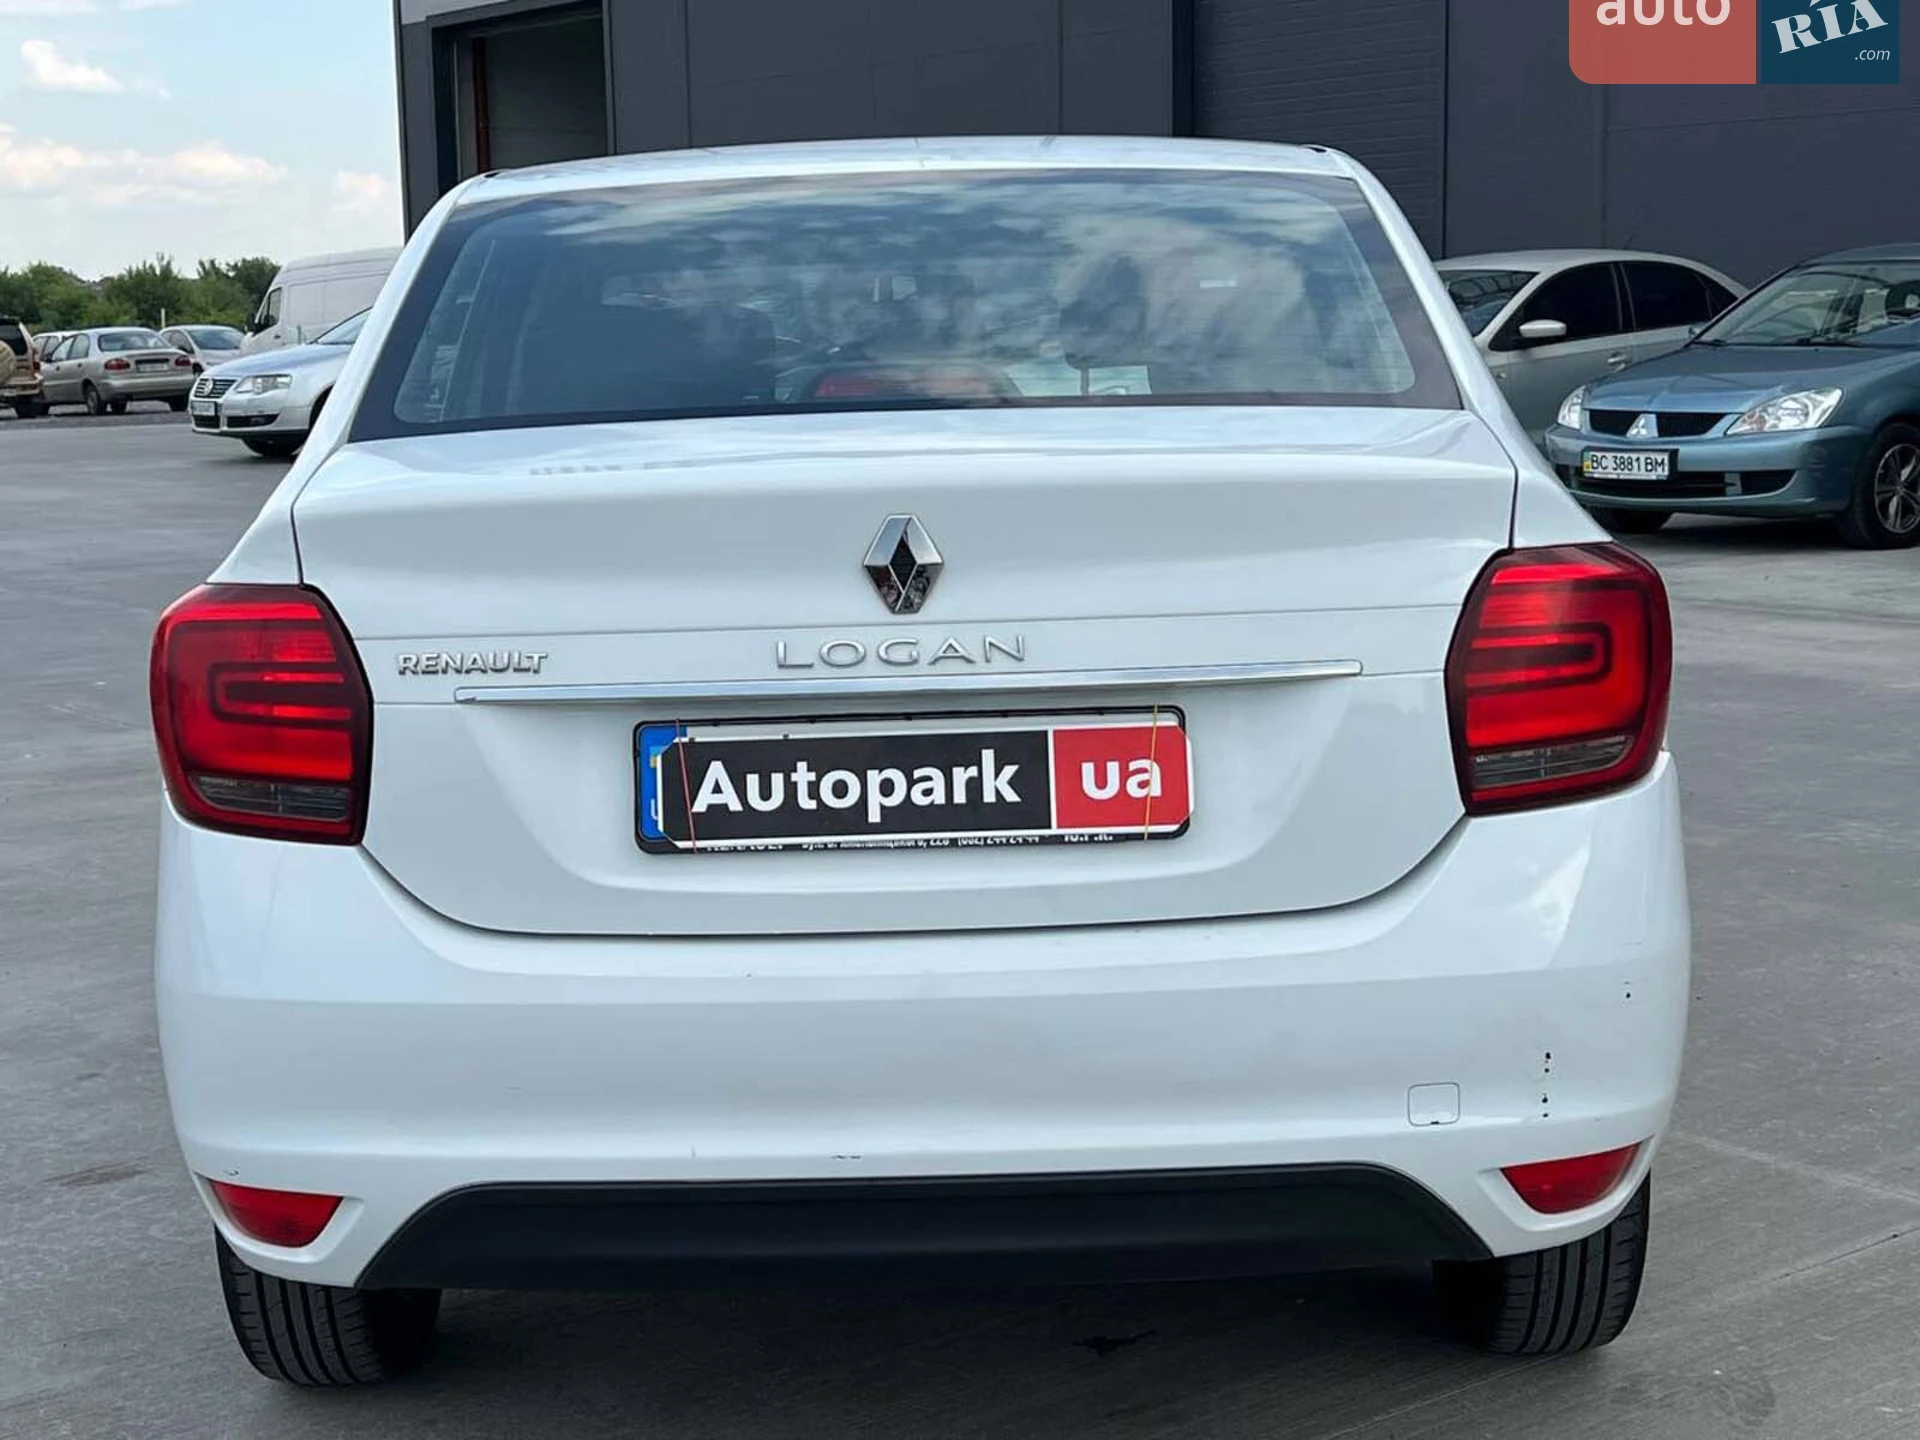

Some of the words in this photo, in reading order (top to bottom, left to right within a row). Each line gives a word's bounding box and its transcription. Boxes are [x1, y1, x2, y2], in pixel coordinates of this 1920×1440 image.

[1590, 454, 1609, 471] BC
[1611, 455, 1642, 472] 3881
[1644, 456, 1666, 473] BM
[397, 651, 549, 675] RENAULT
[776, 634, 1027, 670] LOGAN
[690, 749, 1021, 823] Autopark
[1080, 754, 1163, 802] ua
